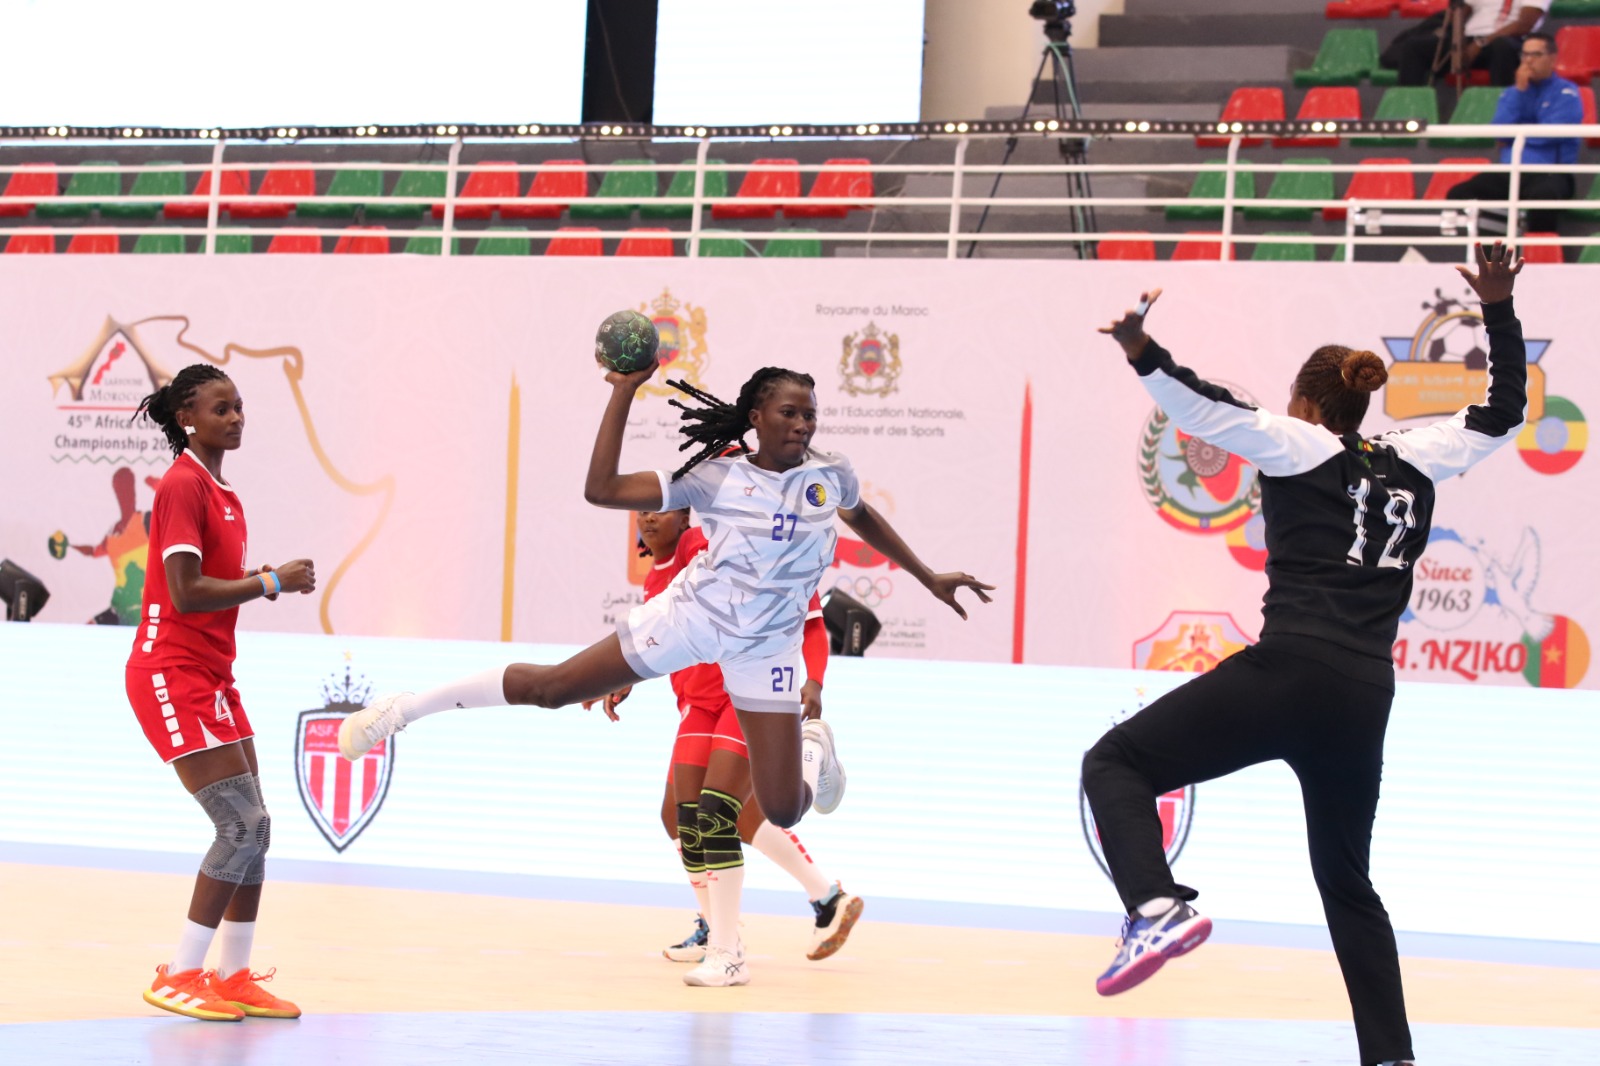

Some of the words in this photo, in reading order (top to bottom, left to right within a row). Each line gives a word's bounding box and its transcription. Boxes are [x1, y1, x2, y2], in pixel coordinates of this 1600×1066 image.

[816, 304, 870, 317] Royaume
[873, 305, 888, 316] du
[892, 305, 929, 316] Maroc
[95, 415, 132, 429] Africa
[137, 416, 163, 430] Clu
[822, 406, 838, 416] de
[816, 424, 870, 435] réscolaire
[873, 425, 885, 436] et
[888, 425, 908, 436] des
[911, 425, 945, 437] Sports
[54, 435, 148, 451] Championship
[771, 513, 798, 541] 27
[1346, 478, 1416, 570] 12
[1416, 558, 1472, 582] Since
[1416, 588, 1472, 612] 1963
[1420, 639, 1528, 681] NZIKO
[771, 666, 794, 692] 27
[215, 690, 236, 726] 4
